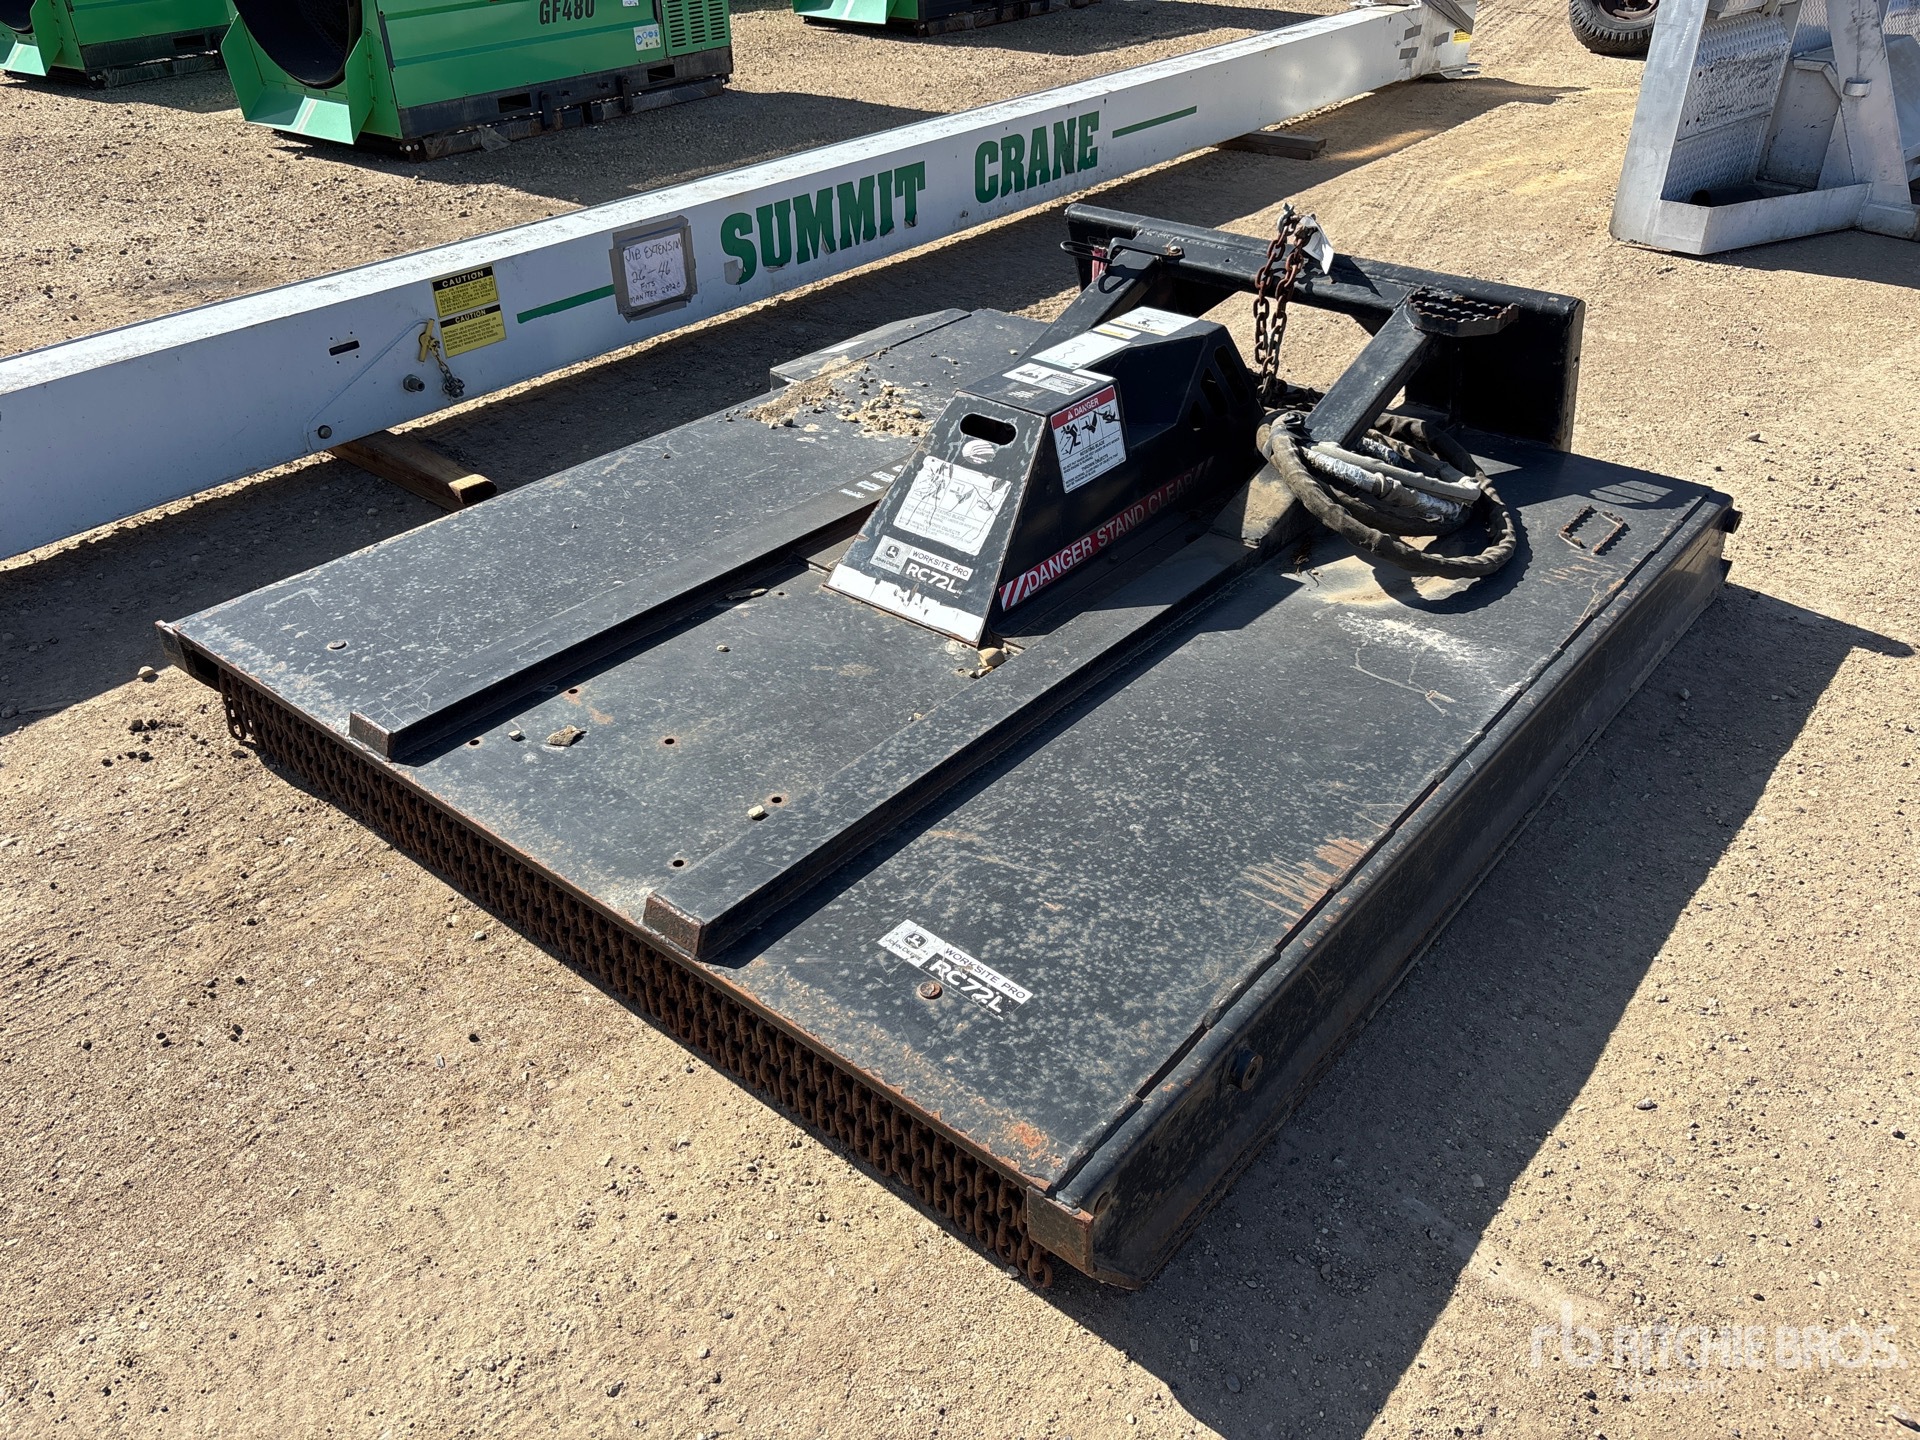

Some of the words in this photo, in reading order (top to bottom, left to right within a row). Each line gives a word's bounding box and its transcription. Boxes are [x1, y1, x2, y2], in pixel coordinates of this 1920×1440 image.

[540, 0, 594, 25] GF480
[720, 161, 926, 285] SUMMIT
[974, 110, 1100, 204] CRANE
[625, 247, 642, 262] JIB
[441, 270, 484, 288] CAUTION
[640, 281, 656, 290] FITS
[630, 288, 658, 304] MANITEX
[454, 309, 487, 324] CAUTION
[1073, 398, 1100, 417] DANGER
[1027, 537, 1093, 592] DANGER
[1097, 504, 1145, 548] STAND
[1149, 473, 1194, 514] CLEAR
[912, 551, 951, 570] WORKSITE
[952, 567, 970, 577] PRO
[904, 562, 962, 594] RC72L
[927, 959, 1011, 1013] RC72L
[944, 948, 1000, 984] WORKSITE
[1001, 982, 1027, 999] PRO
